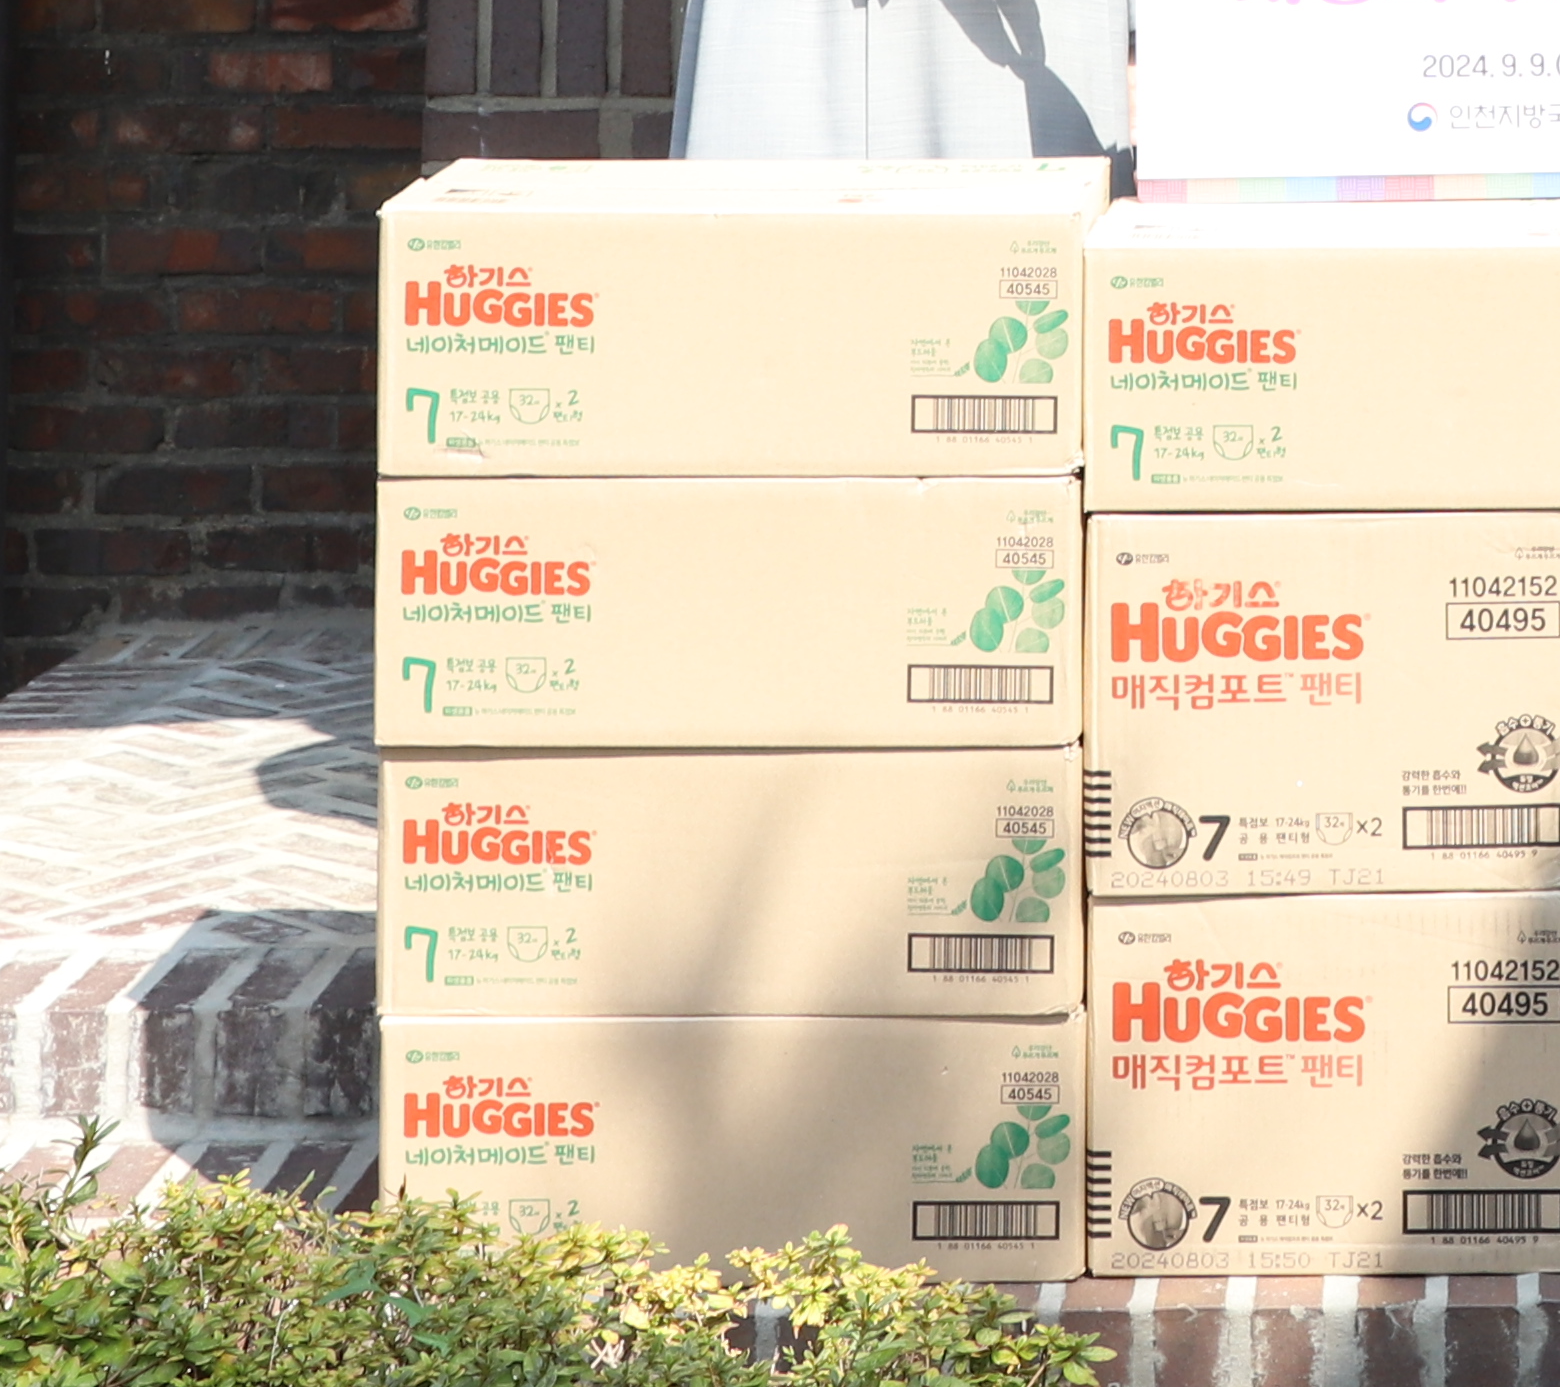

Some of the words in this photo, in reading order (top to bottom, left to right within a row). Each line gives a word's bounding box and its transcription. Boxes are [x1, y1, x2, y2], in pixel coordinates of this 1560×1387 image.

[1422, 54, 1494, 78] 2024.
[444, 264, 531, 288] 하기스
[1001, 267, 1057, 278] 11042028
[1007, 283, 1050, 295] 40545
[404, 280, 595, 328] HUGGIES
[1147, 301, 1234, 325] 하기스
[406, 333, 547, 356] 네이처메이드
[555, 332, 596, 355] 팬티
[1108, 317, 1297, 365] HUGGIES
[1110, 370, 1249, 393] 네이처메이드
[1257, 368, 1298, 391] 팬티
[406, 387, 440, 445] 7
[1111, 424, 1145, 482] 7
[441, 533, 528, 556] 하기스
[997, 536, 1053, 547] 11042028
[1003, 552, 1046, 565] 40545
[401, 549, 591, 597] HUGGIES
[1162, 579, 1279, 610] 하기스
[1448, 576, 1558, 598] 11042152
[402, 601, 543, 625] 네이처메이드
[551, 601, 592, 624] 팬티
[1459, 607, 1547, 632] 40495
[1110, 601, 1364, 662] HUGGIES
[402, 656, 437, 714] 7
[1300, 672, 1363, 705] 팬티
[443, 802, 529, 826] 하기스
[997, 806, 1053, 816] 11042028
[1003, 822, 1046, 834] 40545
[1199, 815, 1231, 860] 7
[403, 818, 592, 866] HUGGIES
[404, 871, 544, 894] 네이처메이드
[552, 870, 593, 893] 팬티
[1111, 871, 1229, 888] 20240803
[1328, 868, 1384, 886] TJ21
[404, 925, 438, 983] 7
[1163, 959, 1281, 991] 하기스
[1451, 960, 1560, 982] 11042152
[1112, 981, 1365, 1043] HUGGIES
[1460, 991, 1549, 1016] 40495
[1002, 1072, 1059, 1083] 11042028
[1301, 1054, 1364, 1087] 팬티
[443, 1075, 531, 1098] 하기스
[1008, 1088, 1052, 1100] 40545
[403, 1091, 595, 1139] HUGGIES
[405, 1144, 547, 1167] 네이처메이드
[555, 1142, 596, 1165] 팬티
[1199, 1196, 1231, 1242] 7
[1111, 1252, 1229, 1269] 20240803
[1328, 1252, 1383, 1268] TJ21
